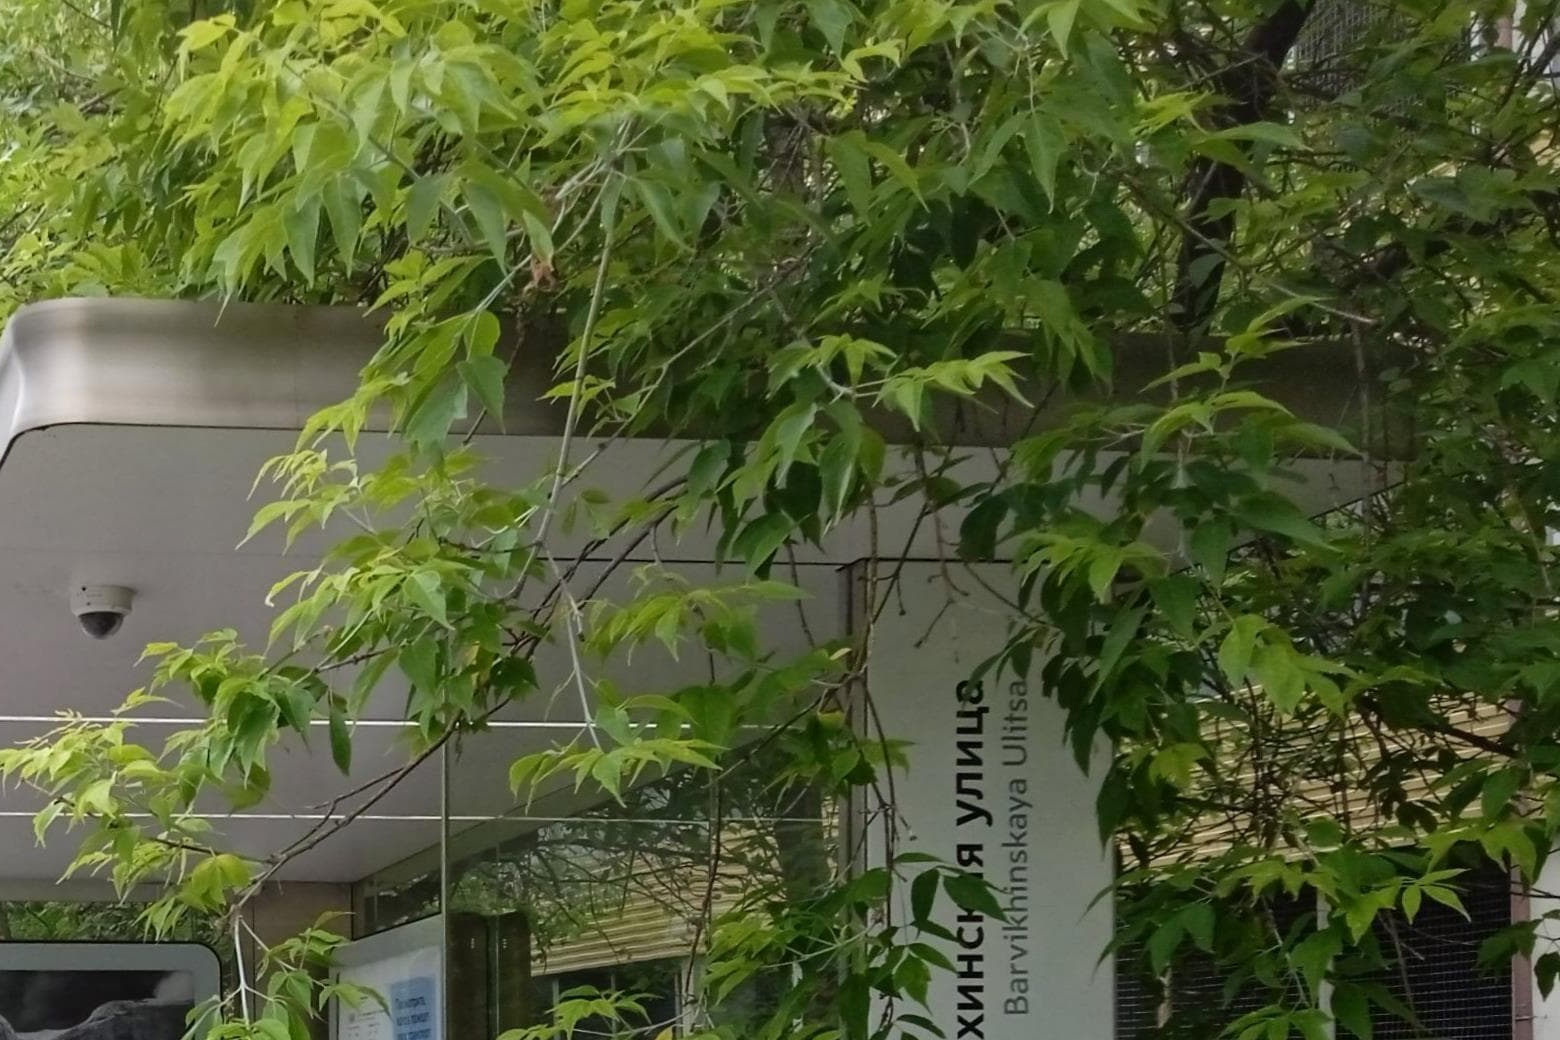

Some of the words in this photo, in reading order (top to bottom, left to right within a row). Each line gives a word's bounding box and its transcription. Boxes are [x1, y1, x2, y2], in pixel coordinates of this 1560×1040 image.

[956, 680, 993, 827] улица
[1001, 680, 1028, 766] Ulitsa
[1001, 778, 1033, 1015] Barvikhinskaya
